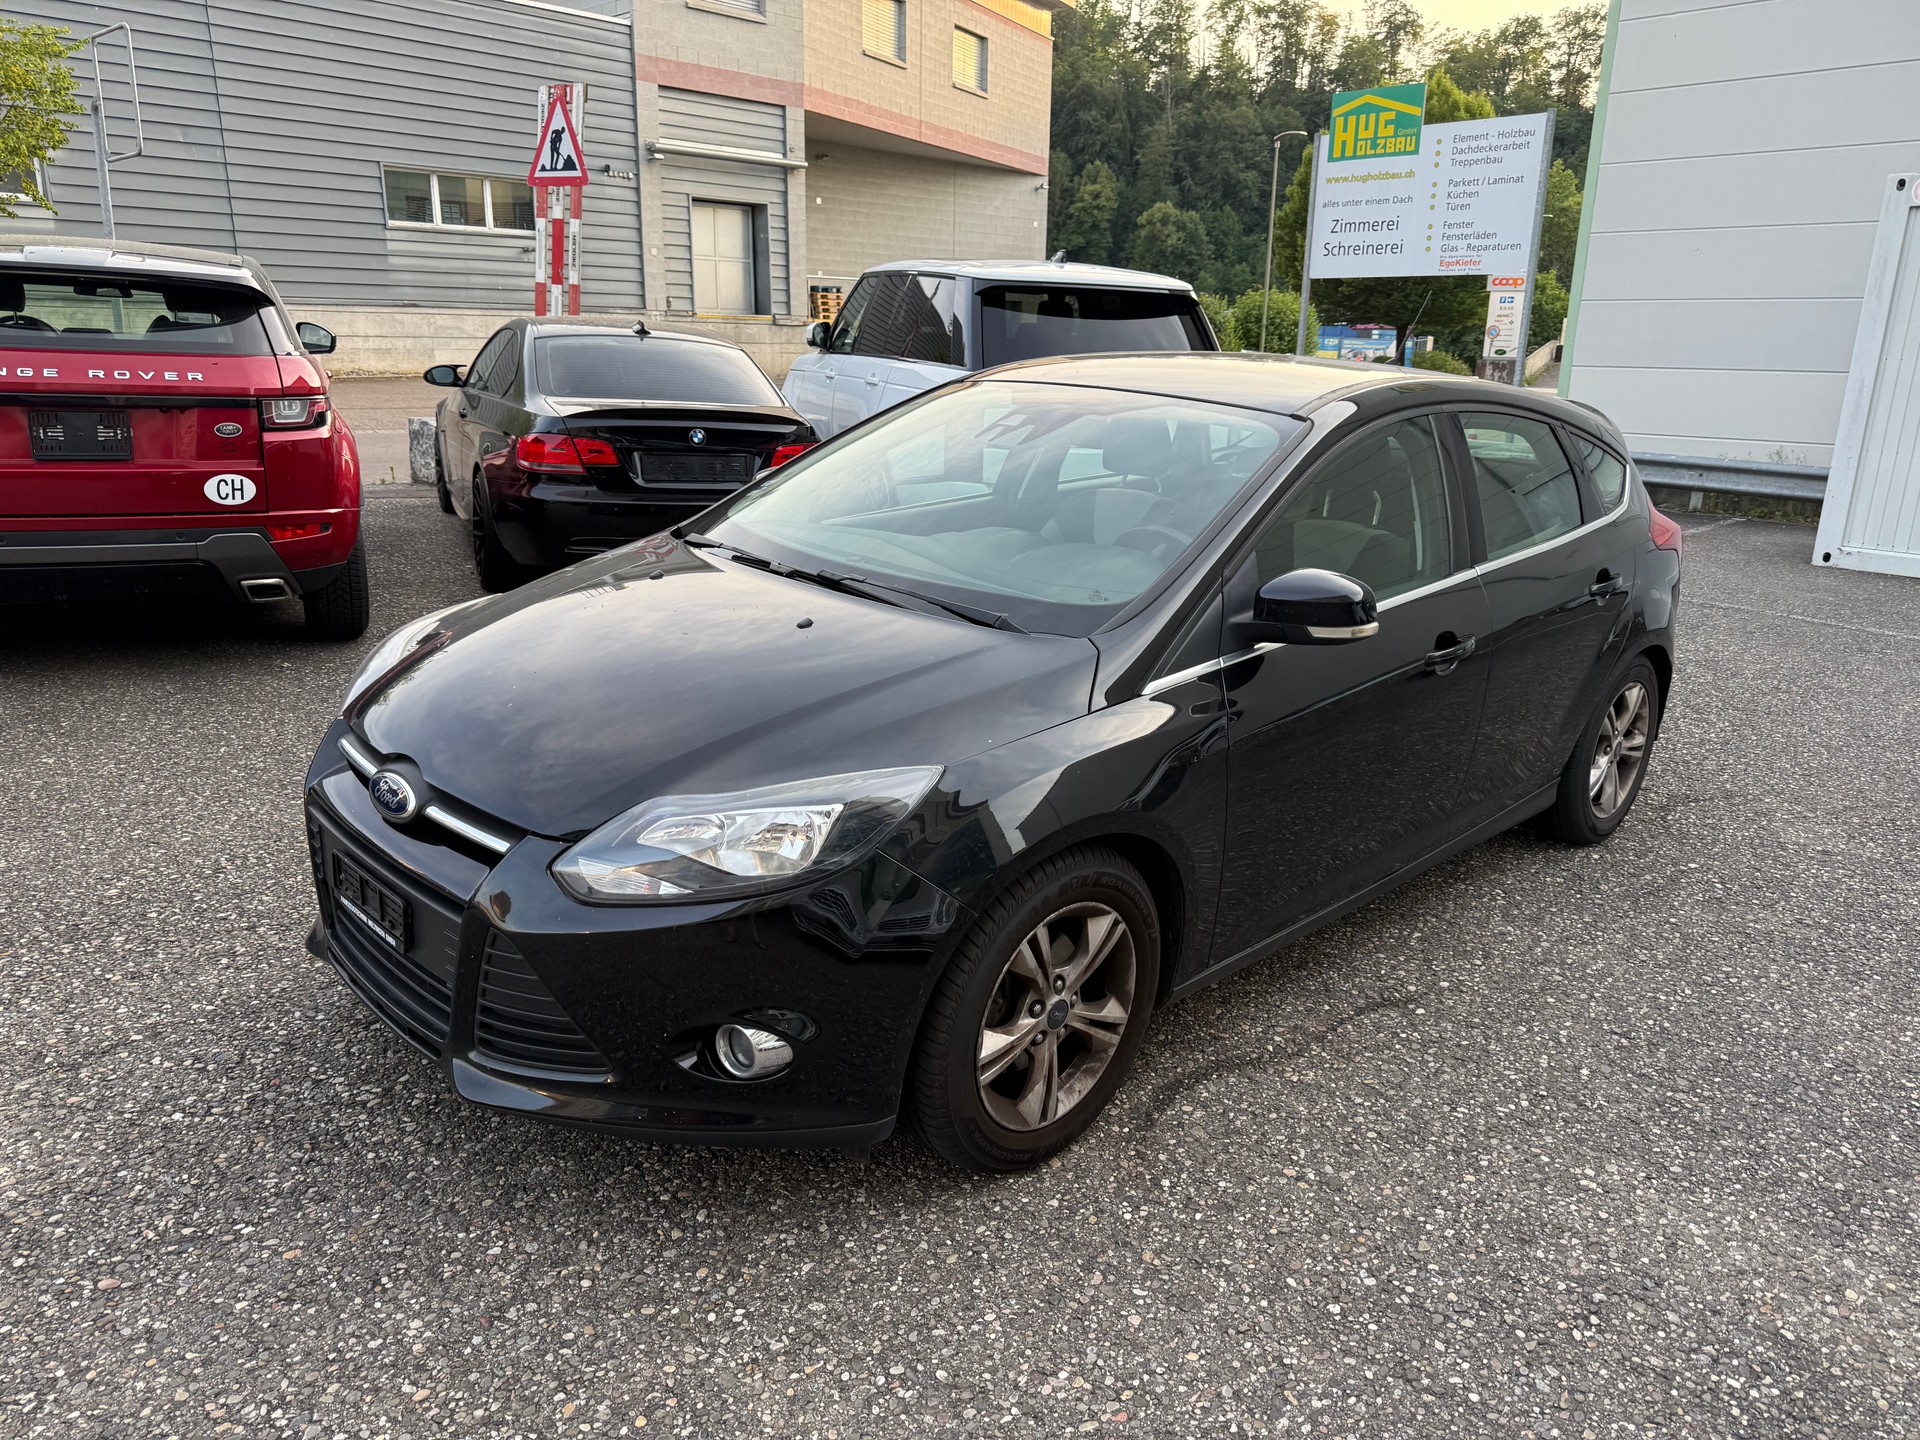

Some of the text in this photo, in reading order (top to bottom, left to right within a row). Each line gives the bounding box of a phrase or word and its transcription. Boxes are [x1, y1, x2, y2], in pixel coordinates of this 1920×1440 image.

[1397, 127, 1417, 136] GmbH
[1453, 132, 1489, 143] Element
[1497, 128, 1536, 139] Holzbau
[1451, 140, 1531, 155] Dachdeckerarbeit
[1451, 155, 1503, 168] Treppenbau
[1325, 169, 1415, 184] www.hugholzbau.ch
[1448, 178, 1480, 188] Parkett
[1487, 175, 1524, 186] Laminat
[1322, 195, 1413, 208] alles unter einem Dach
[1446, 190, 1479, 200] Küchen
[1446, 202, 1471, 212] Türen
[1330, 215, 1400, 234] Zimmerei
[1442, 221, 1475, 230] Fenster
[1441, 231, 1498, 241] Fensterläden
[1322, 238, 1404, 257] Schreinerei
[1440, 243, 1459, 253] Glas
[1466, 242, 1522, 253] Reparaturen
[1439, 258, 1482, 268] EgoKiefer
[1492, 277, 1525, 288] coop
[88, 369, 204, 381] ROVER
[216, 479, 245, 500] CH
[374, 779, 403, 810] Ford
